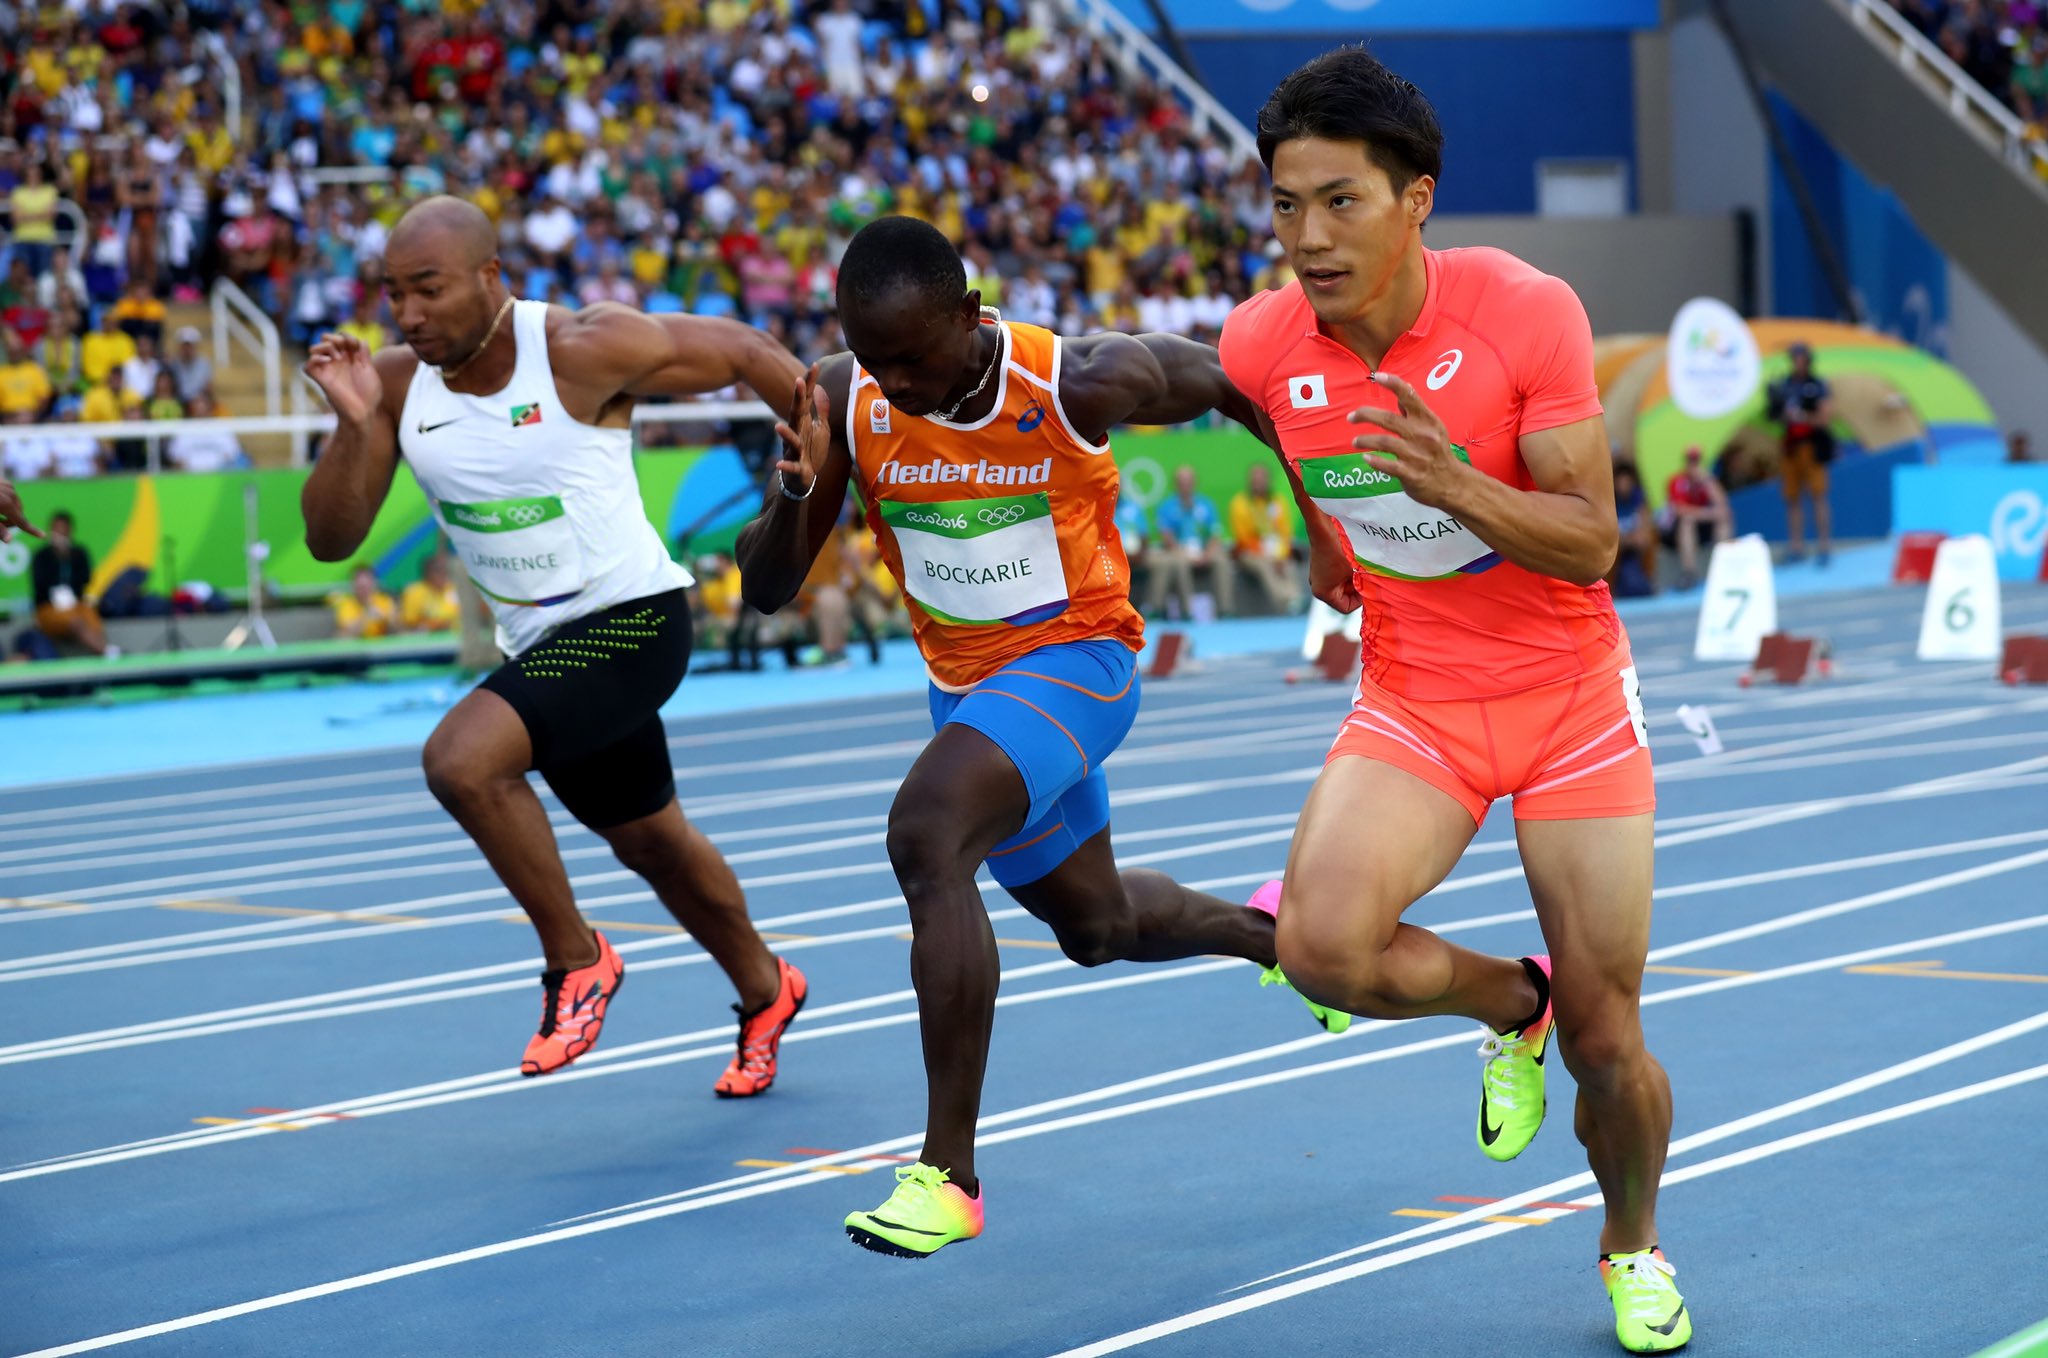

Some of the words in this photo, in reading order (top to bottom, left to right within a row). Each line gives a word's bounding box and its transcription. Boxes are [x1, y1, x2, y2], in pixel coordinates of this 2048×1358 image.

[906, 511, 968, 530] Rio2016
[1359, 517, 1463, 544] YAMAGAT
[471, 552, 560, 572] LAWRENCE
[924, 557, 1033, 585] BOCKARIE
[1723, 588, 1749, 631] 7
[1944, 586, 1975, 634] 6
